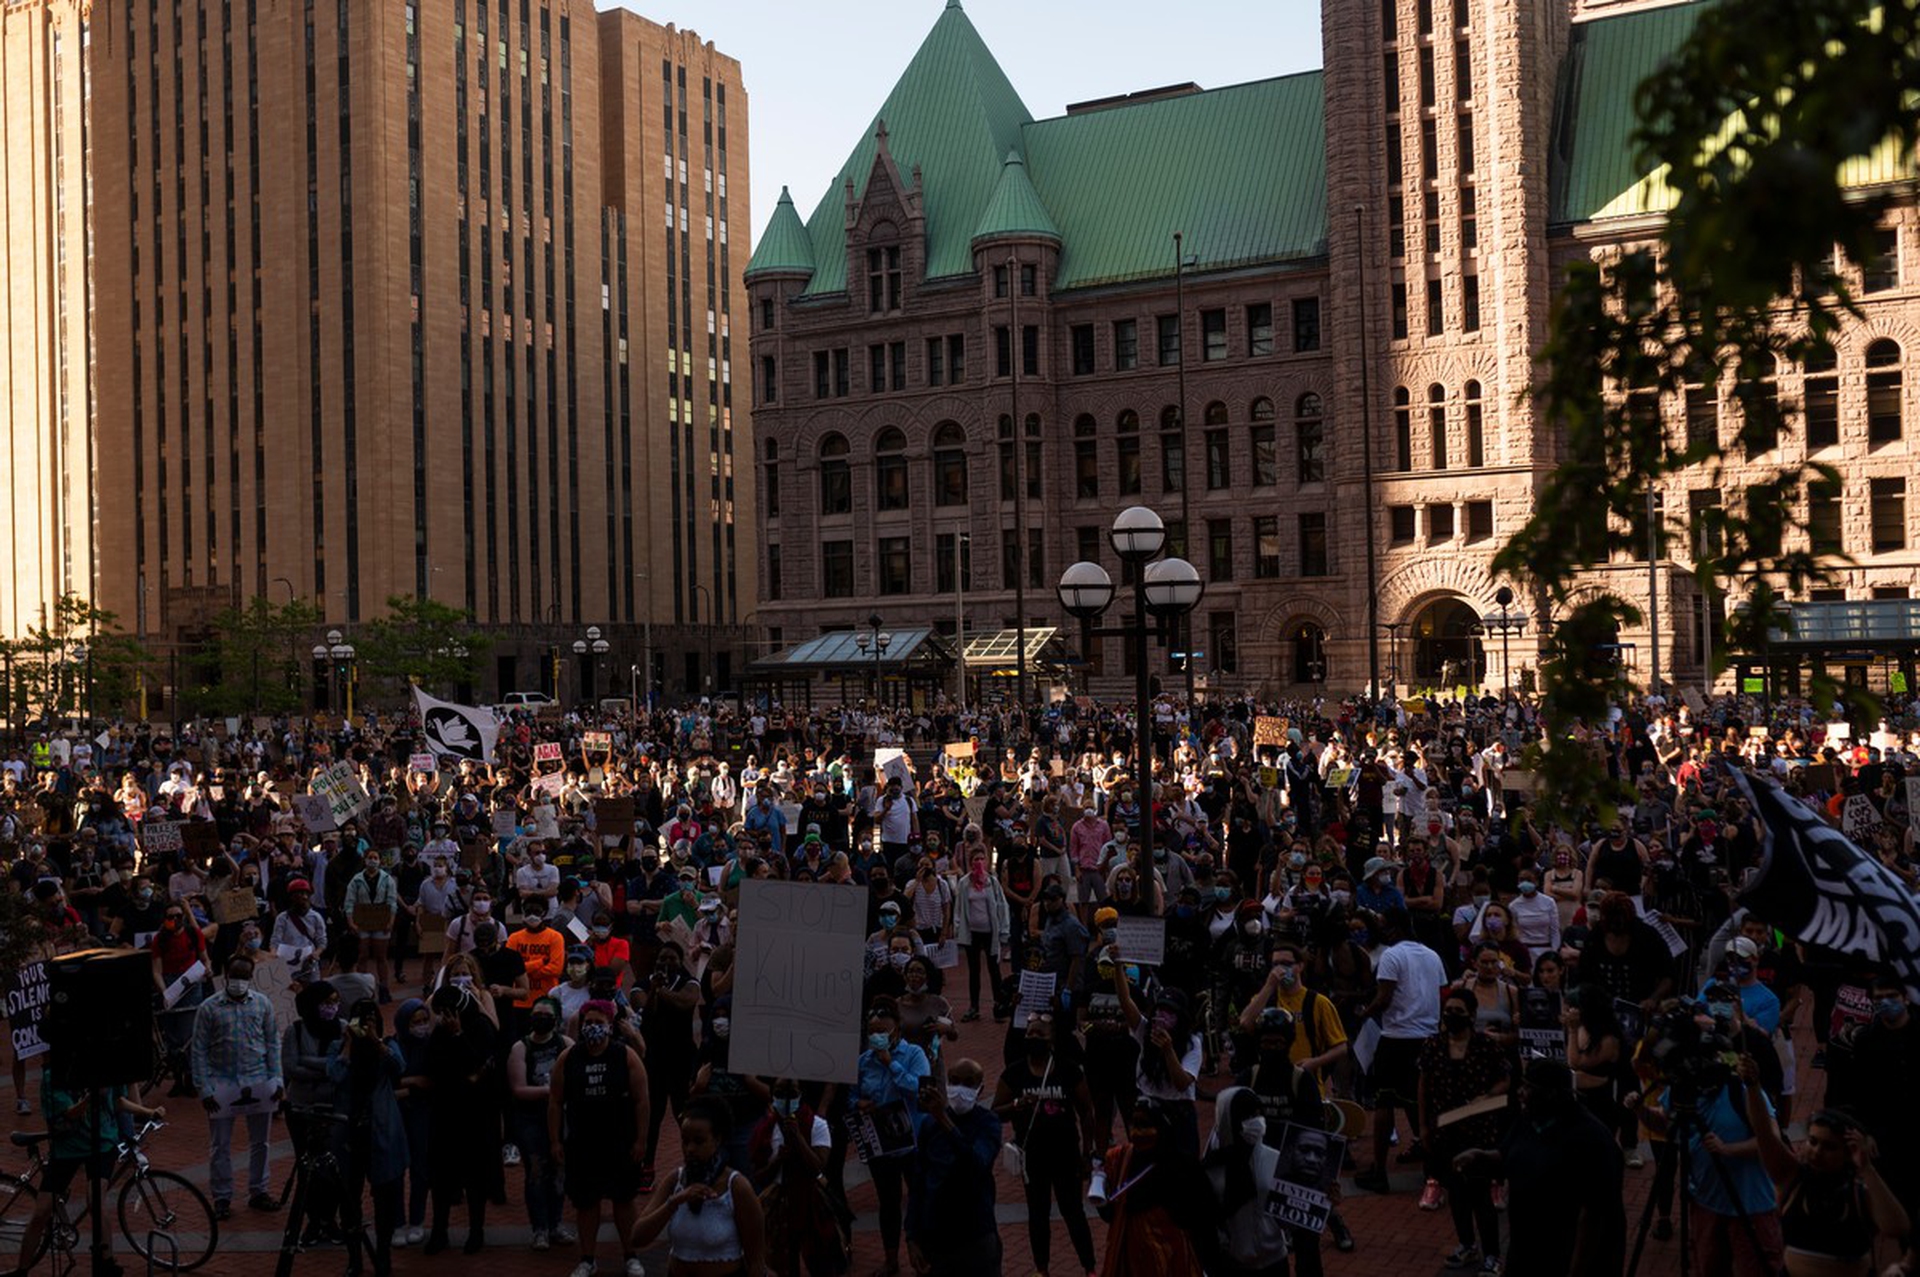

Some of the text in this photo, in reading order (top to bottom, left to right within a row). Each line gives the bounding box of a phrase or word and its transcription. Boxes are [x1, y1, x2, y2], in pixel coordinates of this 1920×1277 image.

[312, 765, 349, 793] POLICE
[326, 781, 349, 801] THE
[1849, 796, 1867, 807] ALL
[331, 793, 361, 815] POLICE
[1848, 804, 1871, 819] COPS
[1854, 815, 1871, 827] ARE
[757, 884, 856, 934] STOP
[18, 962, 48, 988] YOUR
[754, 933, 856, 1017] Killing
[31, 1005, 43, 1022] IS
[1522, 1031, 1561, 1040] JUSTICE
[767, 1024, 836, 1077] US
[588, 1074, 604, 1085] NOT
[1274, 1181, 1325, 1205] JUSTICE
[1268, 1201, 1323, 1230] FLOYD
